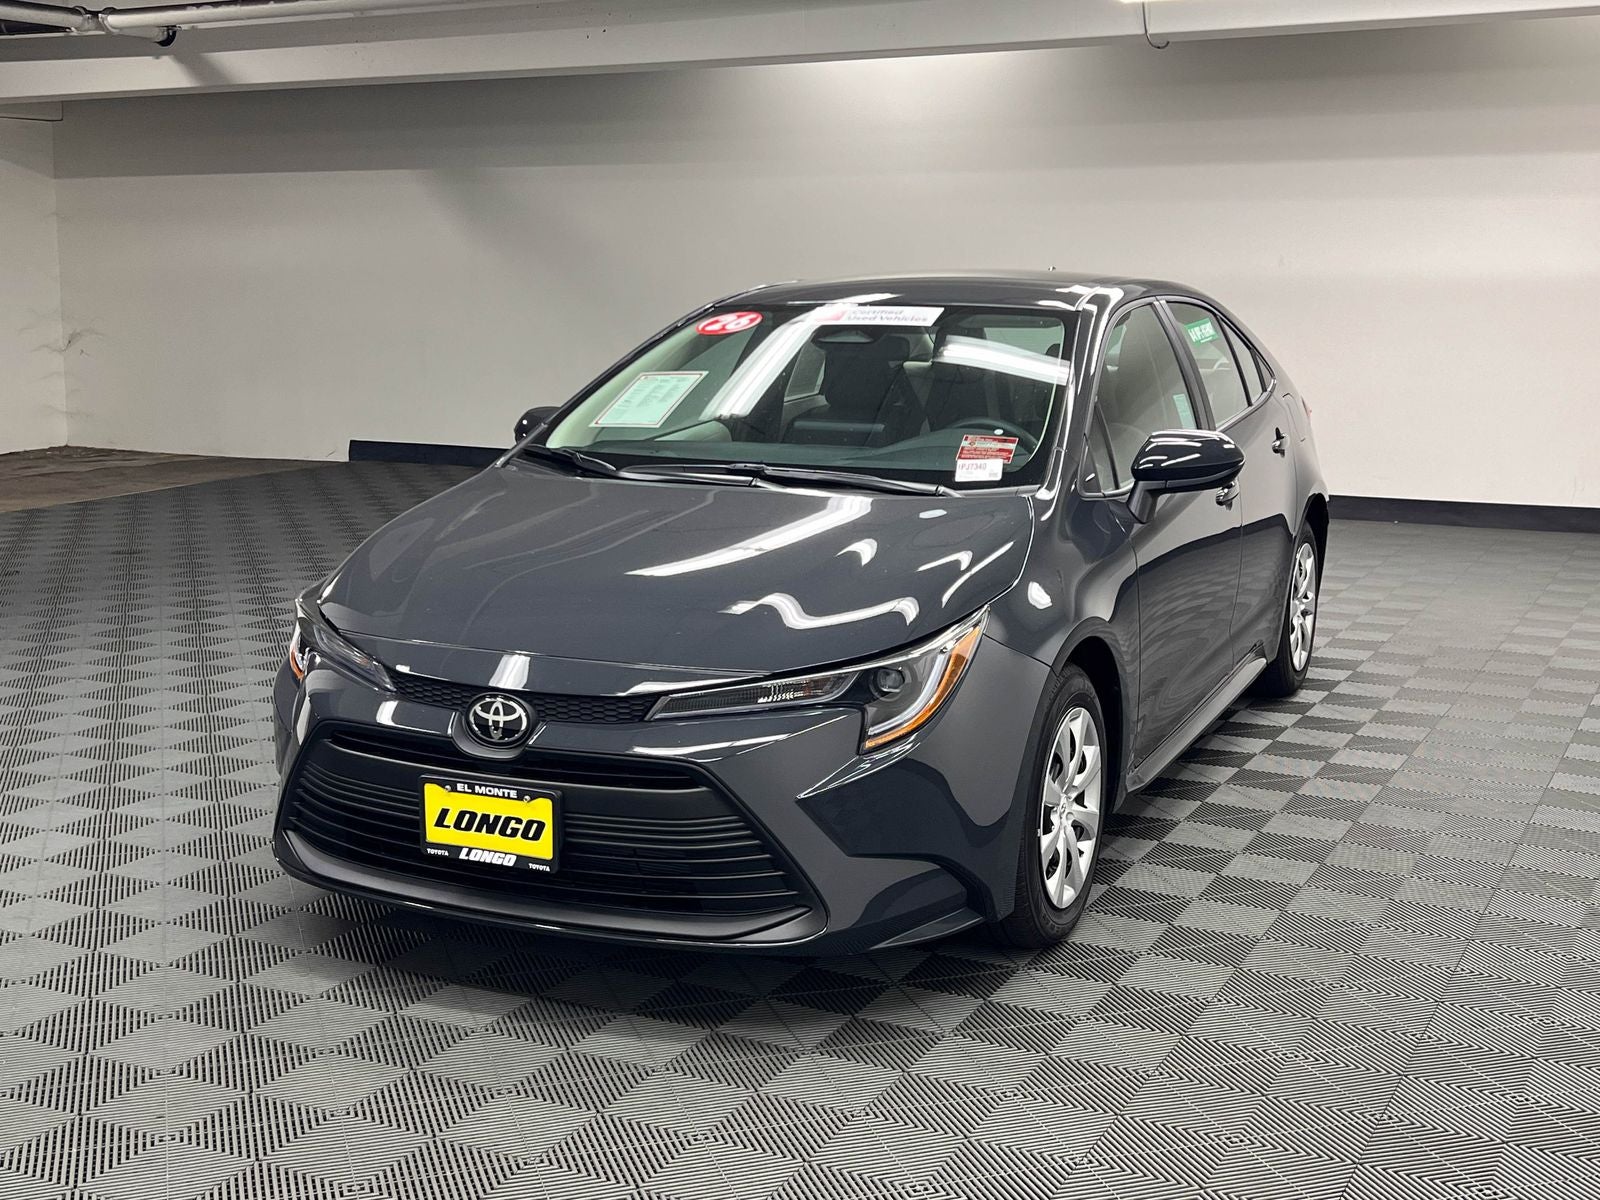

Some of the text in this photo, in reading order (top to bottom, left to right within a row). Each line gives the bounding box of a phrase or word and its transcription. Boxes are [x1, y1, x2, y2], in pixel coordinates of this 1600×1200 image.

[704, 313, 757, 332] 26
[879, 315, 928, 323] Vehicles
[457, 783, 518, 798] EL MONTE
[434, 808, 546, 841] LONGO
[426, 847, 550, 872] TOYOTA LONGO TOYOTA
